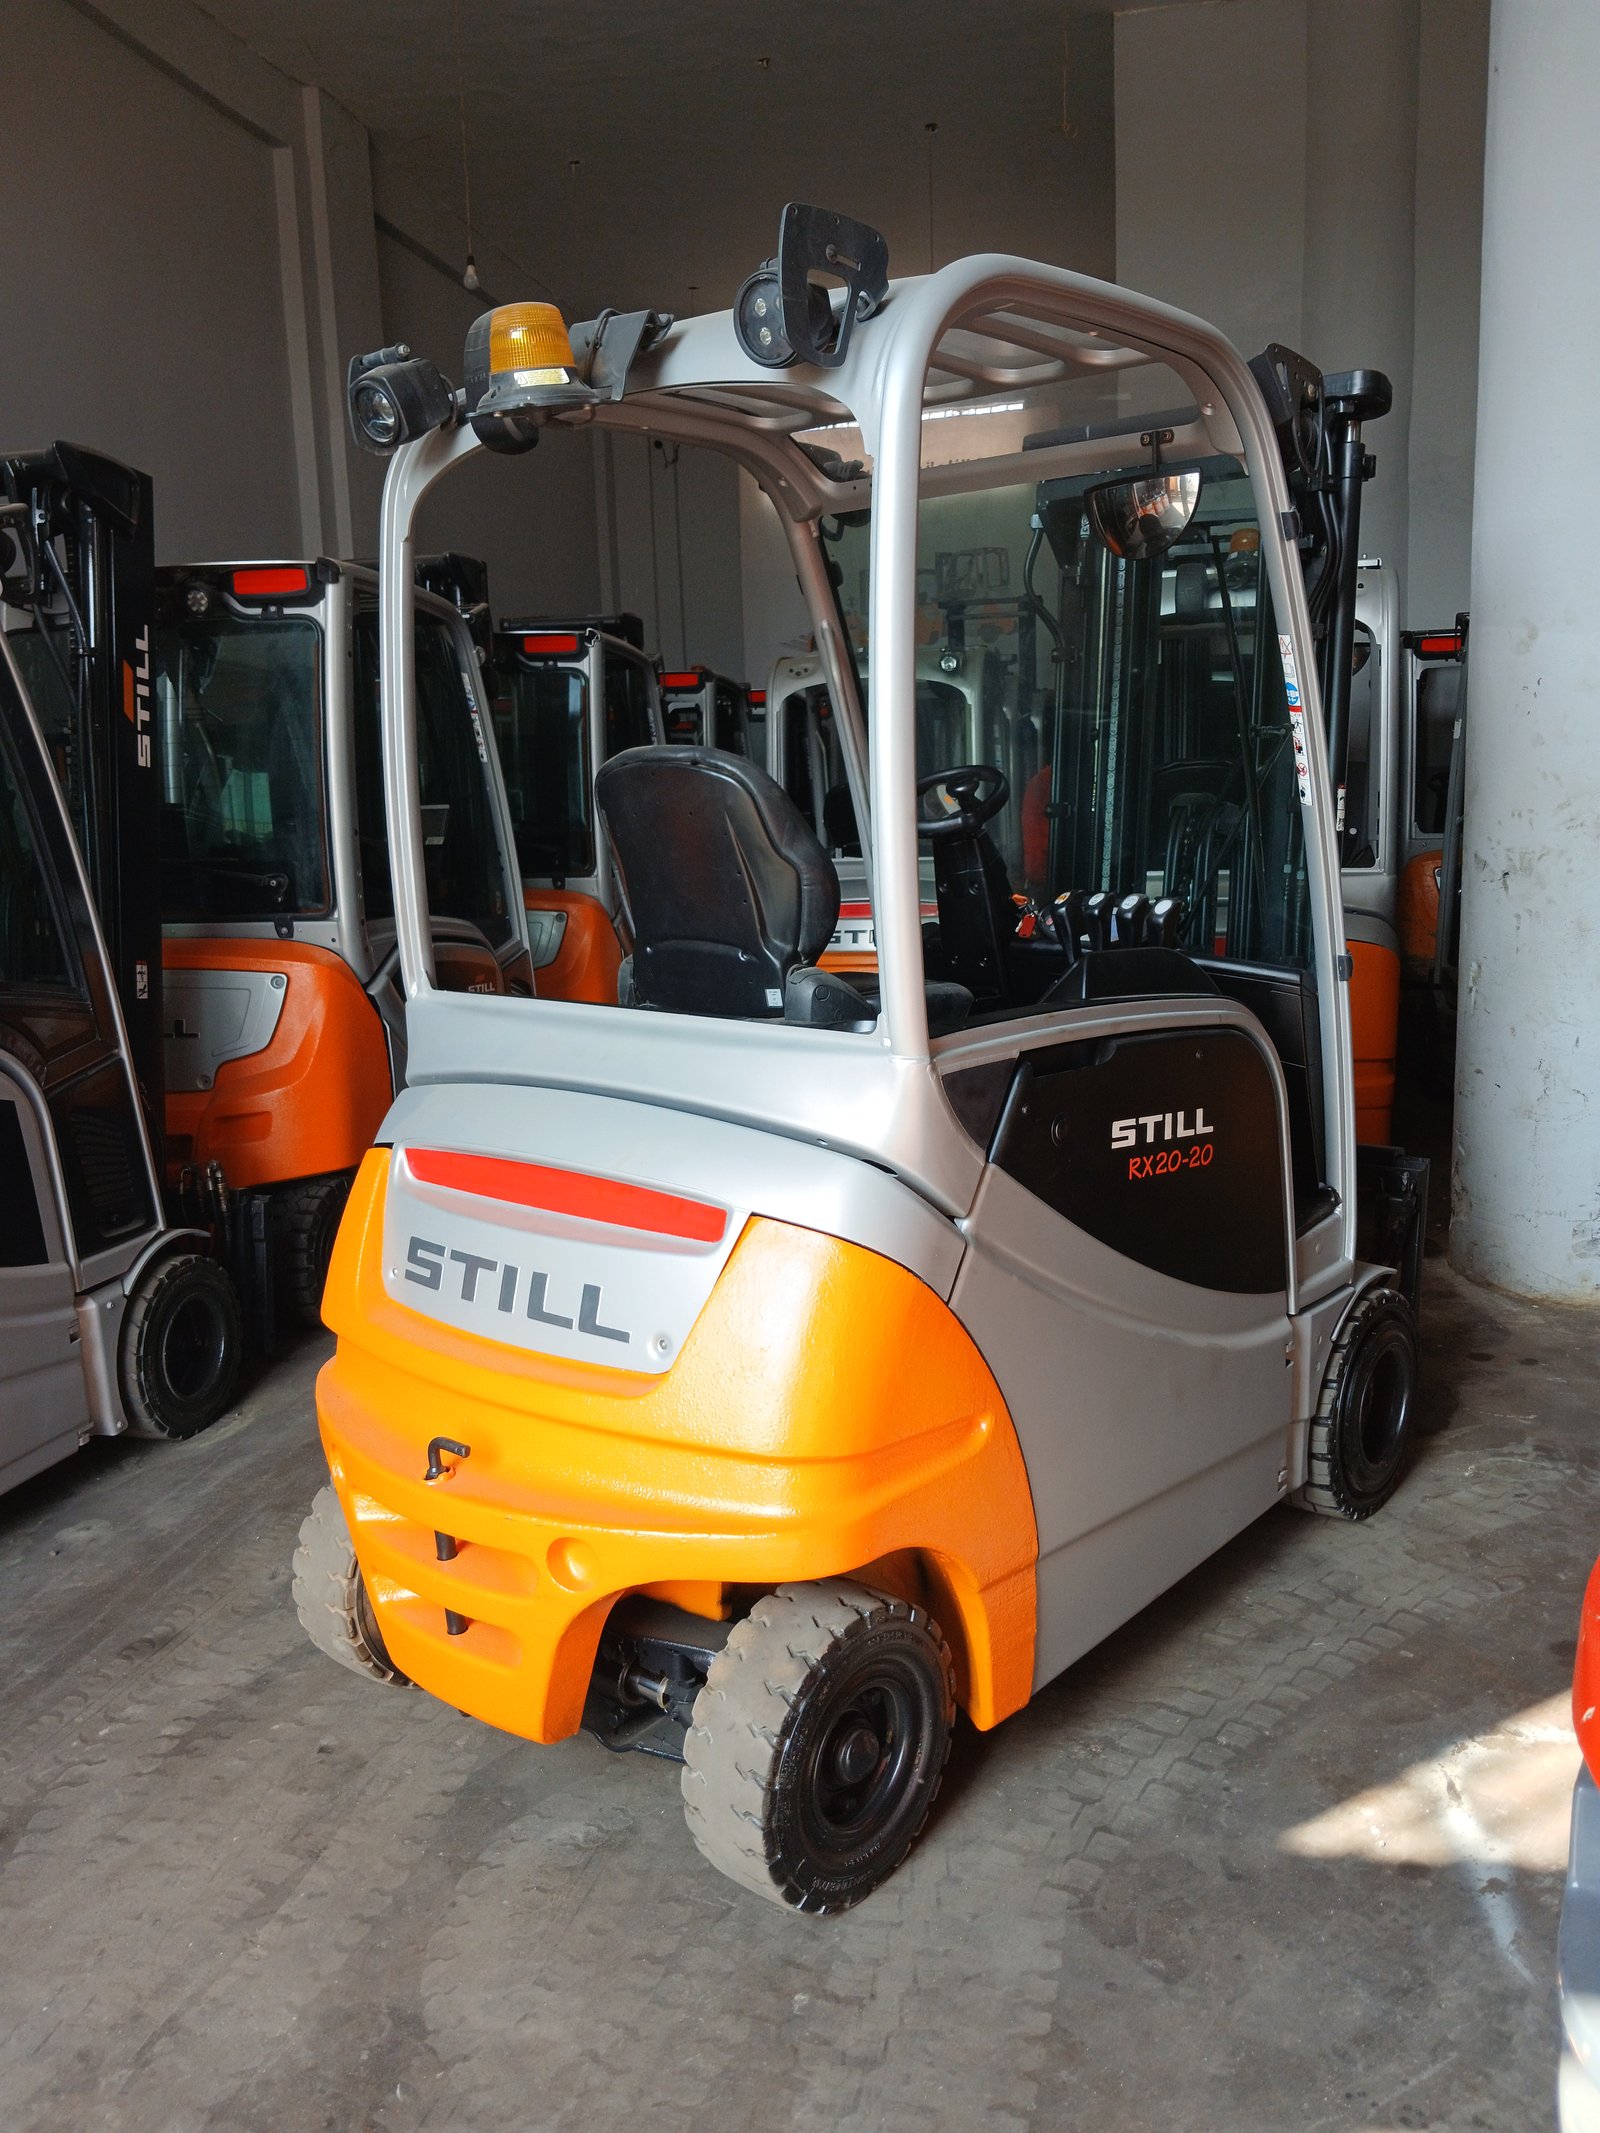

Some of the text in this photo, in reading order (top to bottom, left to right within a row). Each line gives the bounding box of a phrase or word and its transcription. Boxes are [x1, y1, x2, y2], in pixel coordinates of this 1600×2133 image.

[135, 624, 151, 768] STILL
[1111, 1107, 1214, 1149] STILL
[1128, 1143, 1214, 1180] RX20-20
[404, 1235, 632, 1344] STILL
